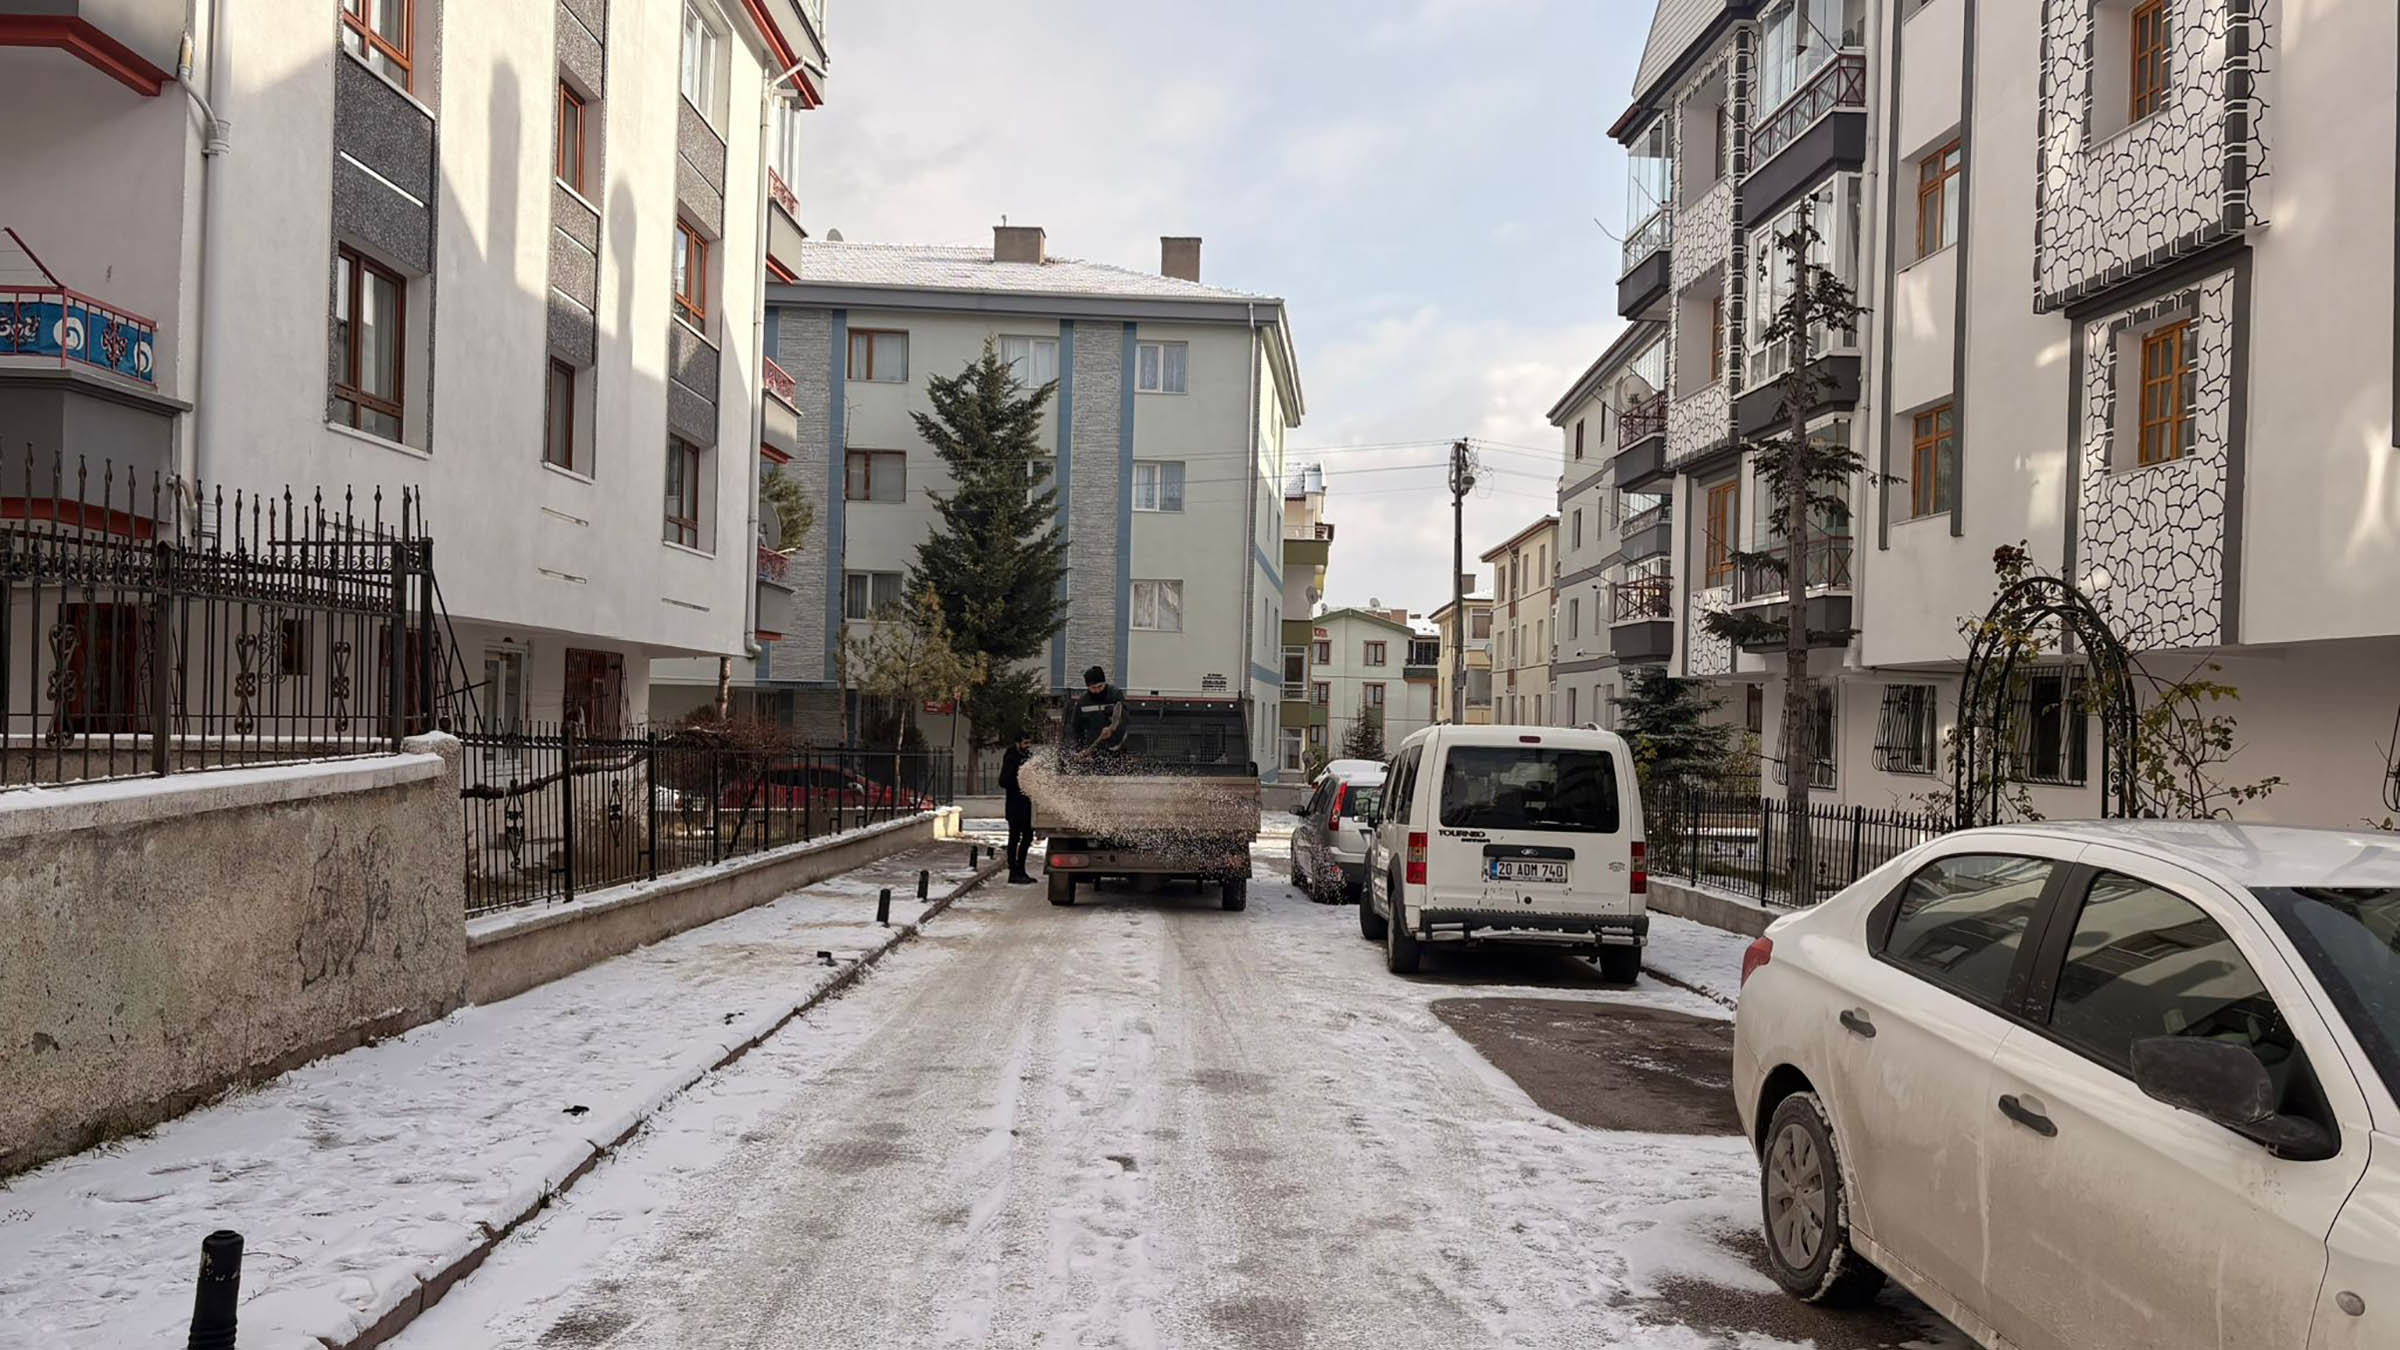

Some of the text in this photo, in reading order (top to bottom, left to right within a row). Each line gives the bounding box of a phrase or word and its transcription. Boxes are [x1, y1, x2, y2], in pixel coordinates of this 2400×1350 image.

[1438, 829, 1486, 838] TOURNEO
[1499, 863, 1563, 877] 20 ADM 740
